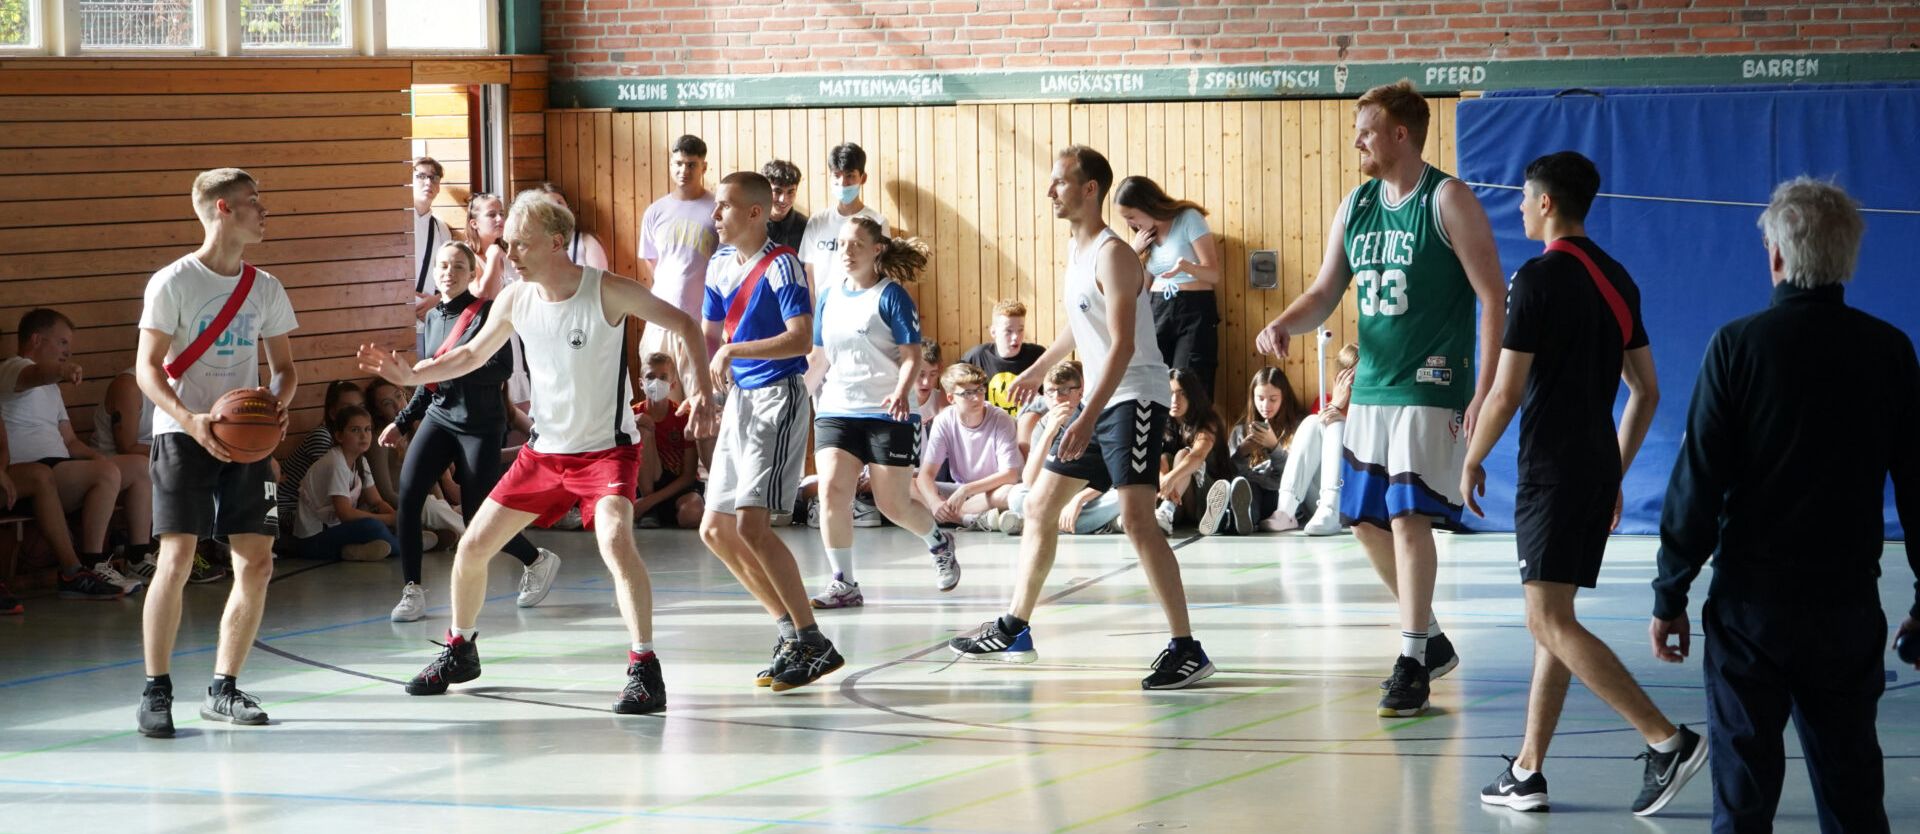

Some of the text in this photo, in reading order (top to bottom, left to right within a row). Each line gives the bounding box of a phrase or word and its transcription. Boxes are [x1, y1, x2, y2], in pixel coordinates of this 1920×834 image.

[1426, 66, 1486, 85] PFERD
[1743, 58, 1818, 78] BARREN
[819, 78, 943, 97] MATTENWAGEN
[1203, 70, 1320, 89] SPRUNGTISCH
[617, 83, 668, 100] KLEINE
[1350, 230, 1415, 268] CELTICS
[1356, 269, 1408, 316] 33
